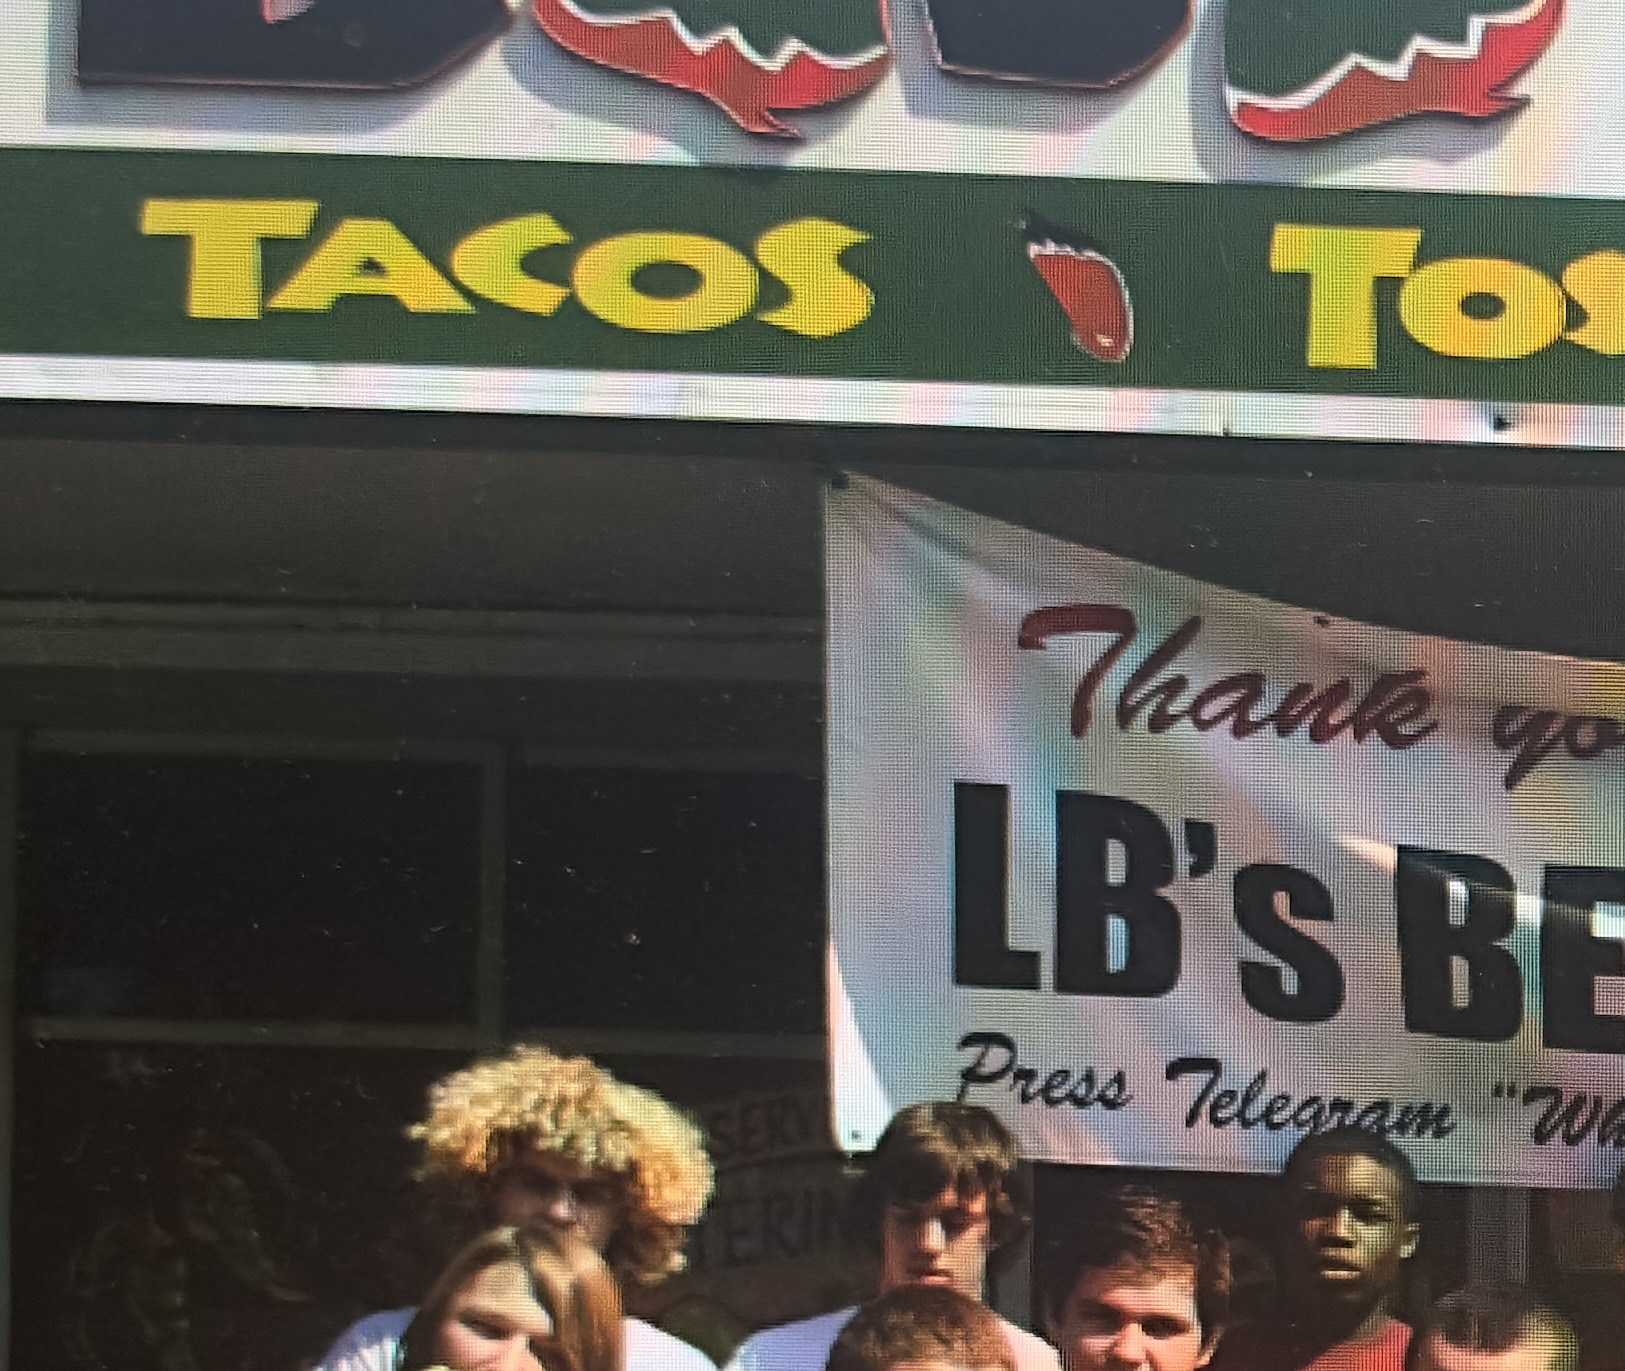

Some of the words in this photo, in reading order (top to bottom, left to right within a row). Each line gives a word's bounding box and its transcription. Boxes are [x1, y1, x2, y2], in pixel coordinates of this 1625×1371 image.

[139, 197, 876, 338] TACOS
[1018, 603, 1442, 750] Thank
[953, 782, 1346, 1024] LB's
[955, 1031, 1133, 1104] Press
[1164, 1057, 1456, 1140] Telegram
